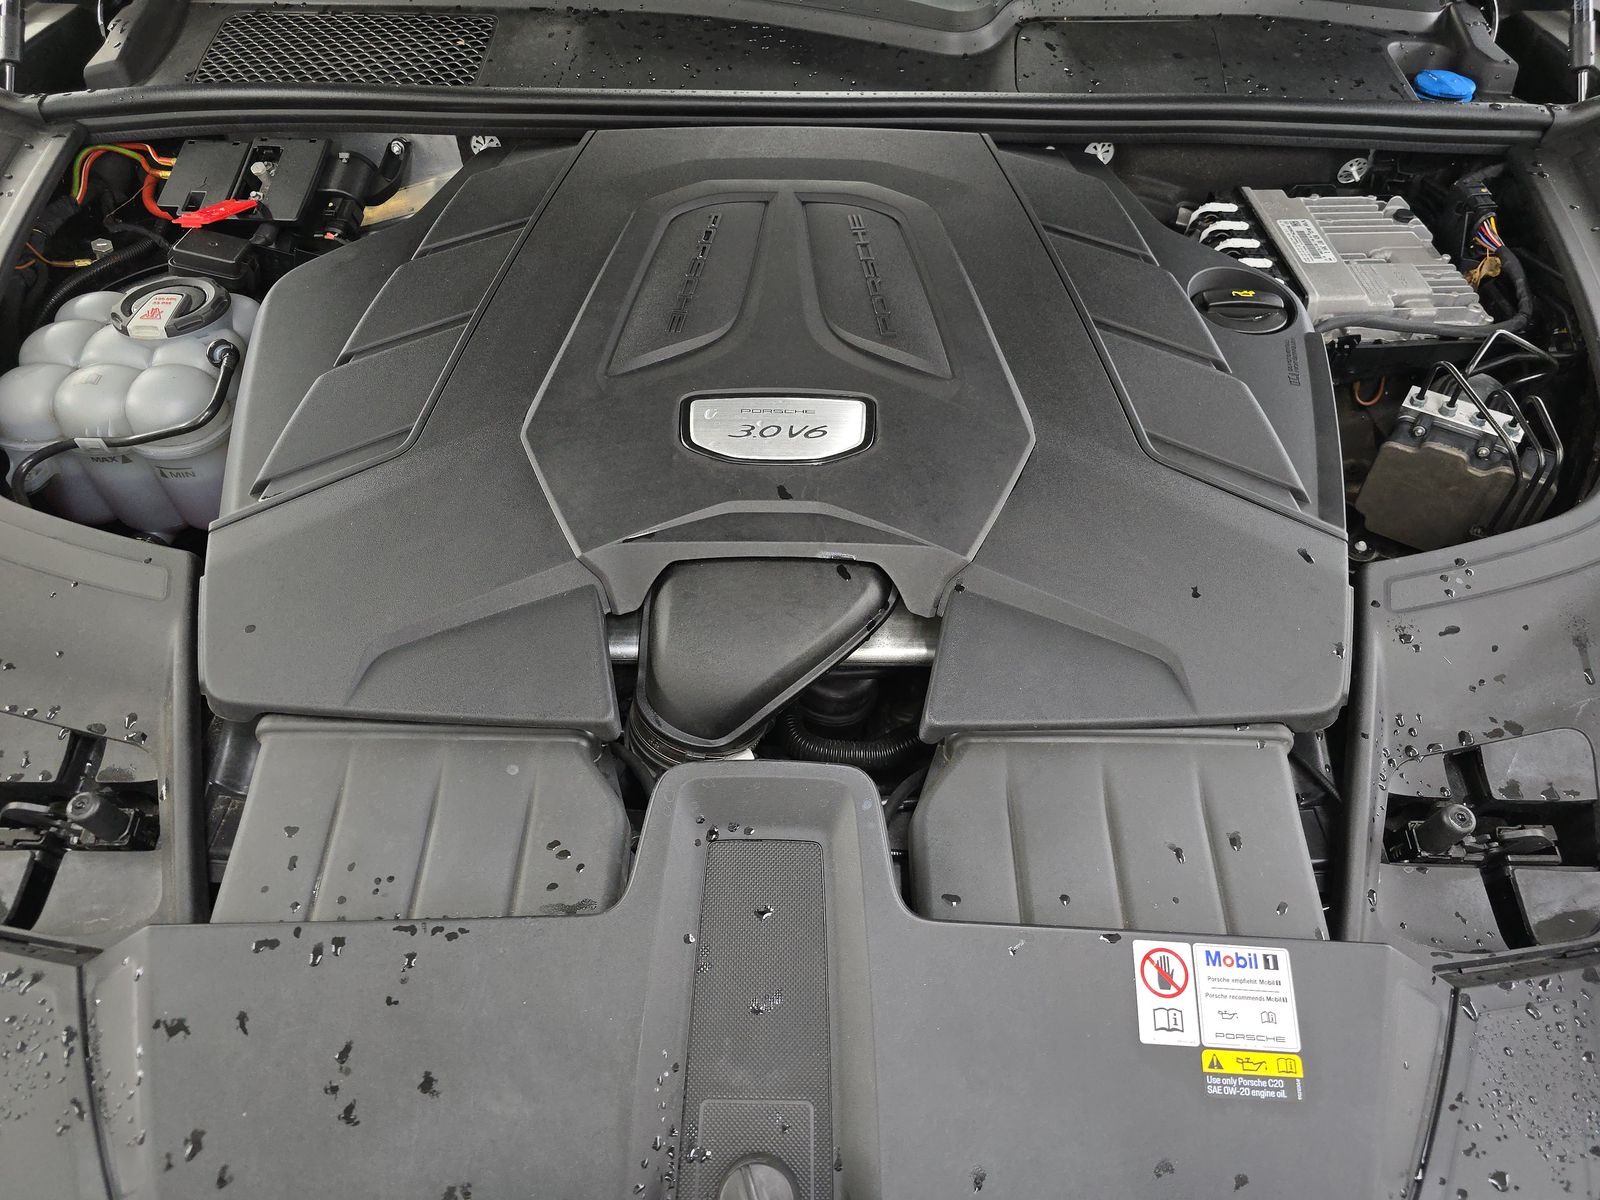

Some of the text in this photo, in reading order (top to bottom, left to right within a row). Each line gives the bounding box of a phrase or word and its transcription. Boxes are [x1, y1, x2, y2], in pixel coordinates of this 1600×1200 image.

[848, 214, 897, 336] PORSCHE
[727, 424, 829, 439] 3.0 V6
[90, 455, 120, 463] MAX
[1204, 950, 1280, 971] Mobil 1
[1207, 975, 1230, 983] Porsche
[1204, 992, 1228, 1000] Porsche
[1229, 994, 1265, 1002] recommends
[1215, 1032, 1286, 1043] PORSCHE
[1206, 1075, 1285, 1088] Use only Porsche C20
[1207, 1085, 1223, 1095] SAE
[1223, 1087, 1251, 1097] 0W-20
[1251, 1089, 1276, 1099] engine
